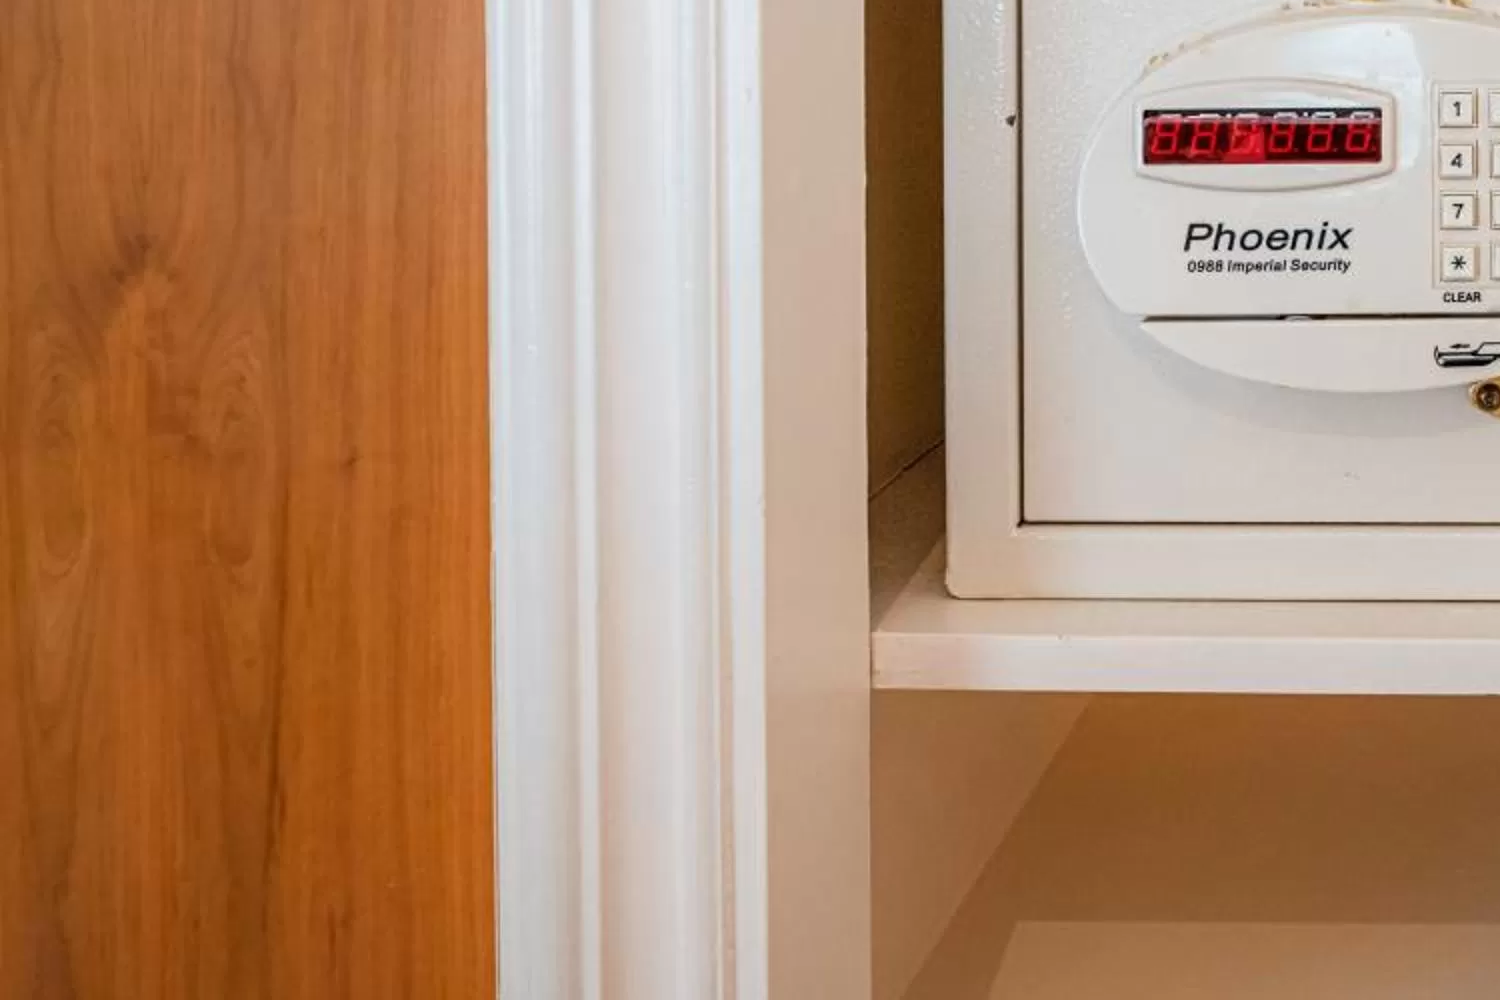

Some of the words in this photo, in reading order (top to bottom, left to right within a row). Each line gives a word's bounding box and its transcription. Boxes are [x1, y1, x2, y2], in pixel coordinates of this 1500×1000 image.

[1452, 101, 1461, 116] 1
[1450, 153, 1463, 168] 4
[1452, 203, 1464, 219] 7
[1183, 221, 1353, 252] Phoenix
[1227, 259, 1287, 274] Imperial
[1290, 259, 1351, 273] Security
[1443, 291, 1481, 303] CLEAR
